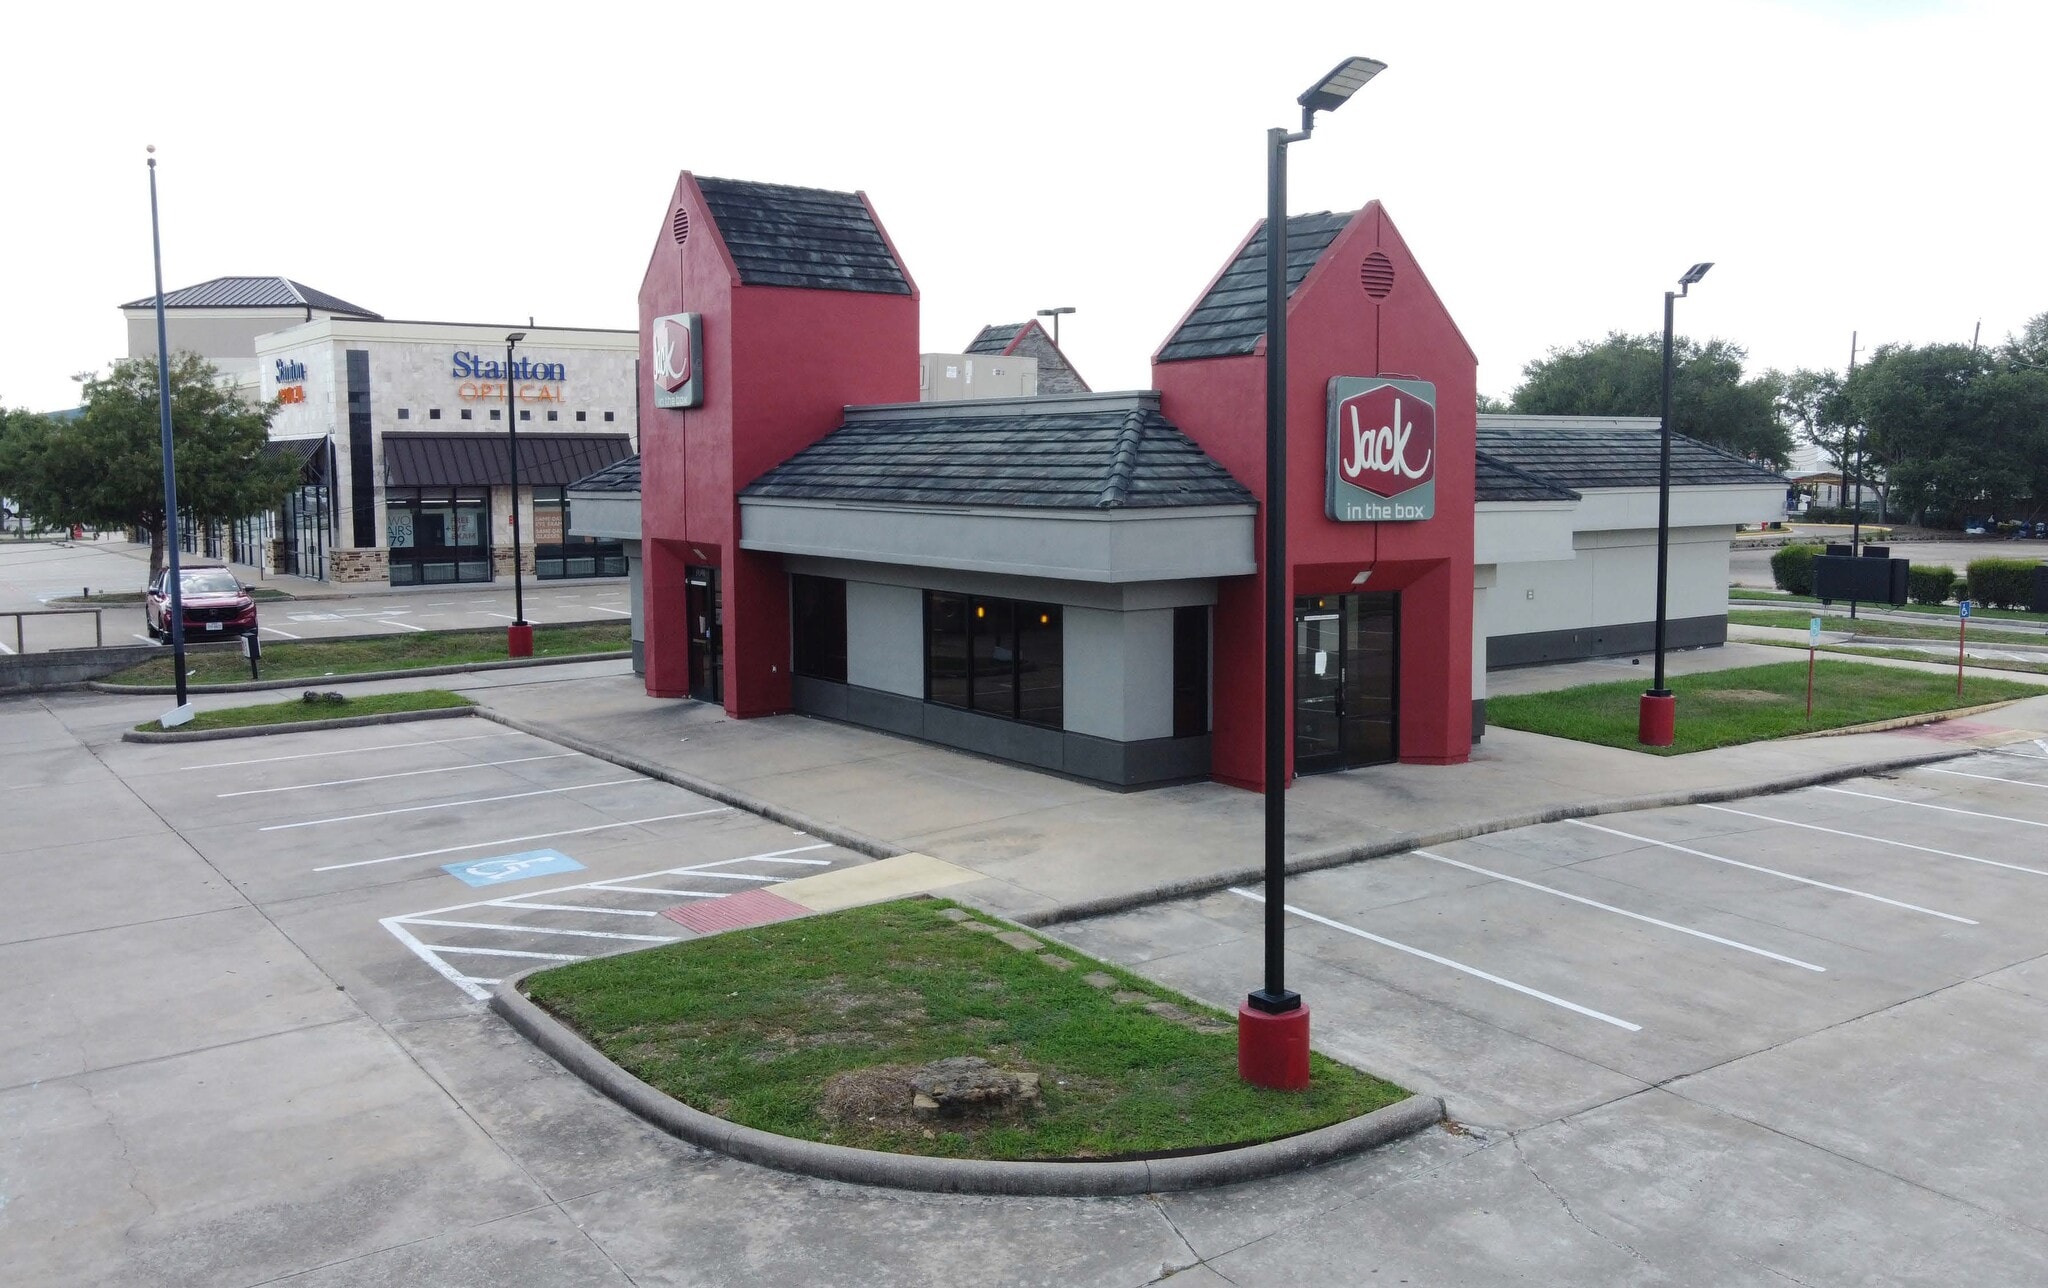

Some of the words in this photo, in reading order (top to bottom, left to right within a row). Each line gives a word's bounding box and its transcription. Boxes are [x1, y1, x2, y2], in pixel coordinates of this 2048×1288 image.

[453, 351, 567, 381] Stanton
[459, 382, 567, 403] OPTCAL
[1344, 398, 1431, 479] Jack
[1347, 502, 1362, 519] in
[1365, 503, 1392, 519] the
[1395, 503, 1424, 519] box
